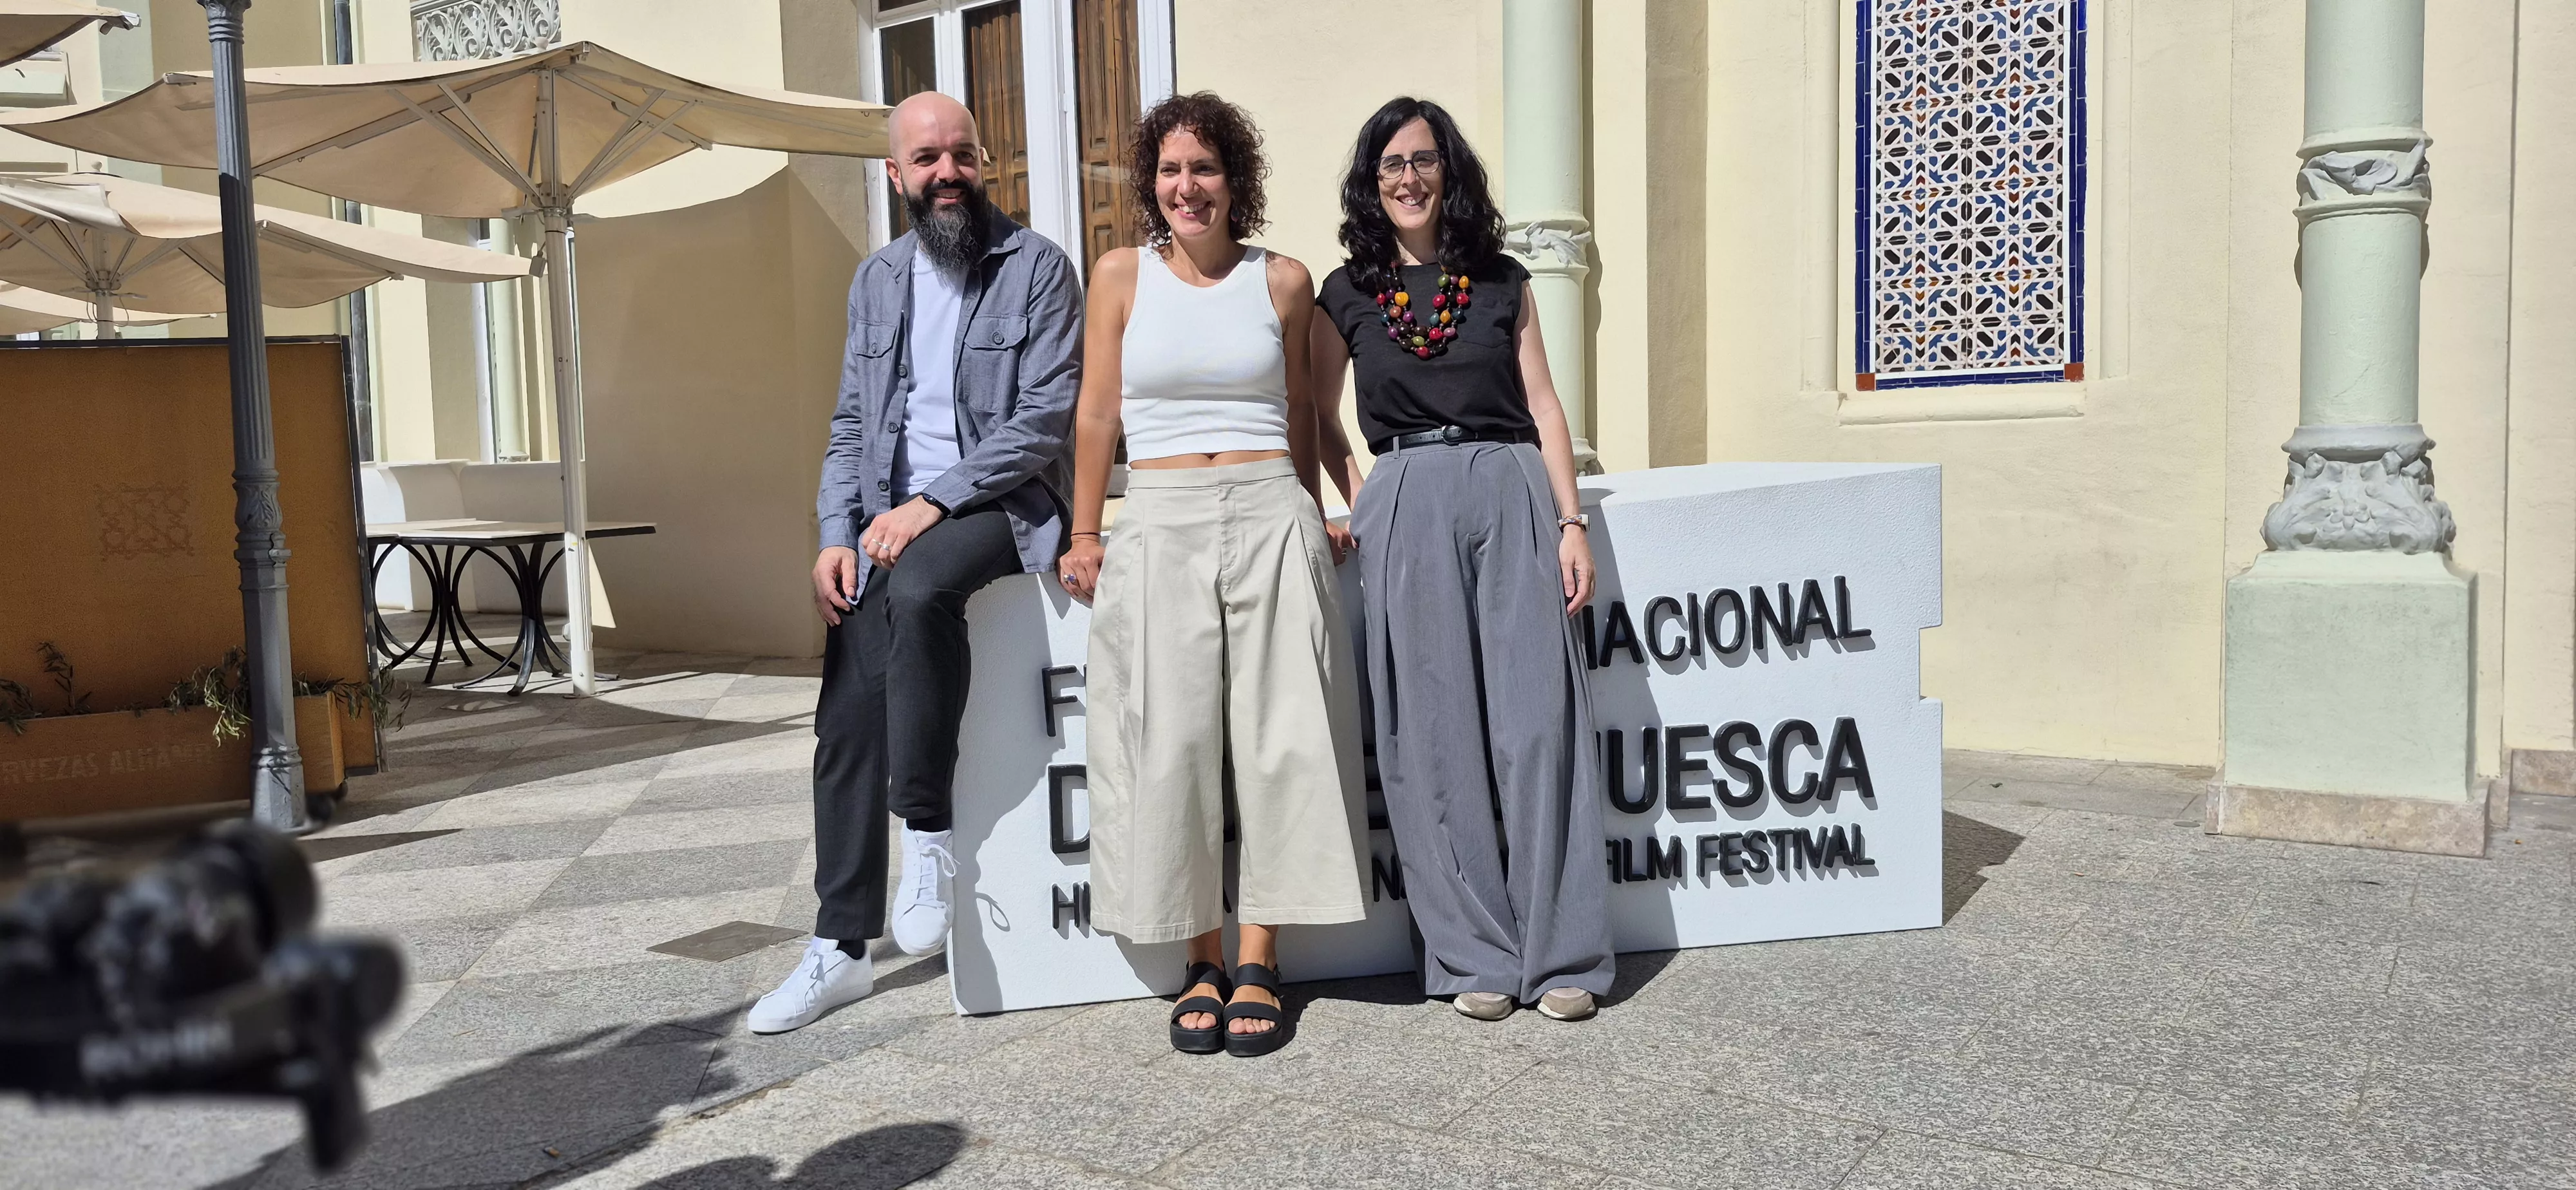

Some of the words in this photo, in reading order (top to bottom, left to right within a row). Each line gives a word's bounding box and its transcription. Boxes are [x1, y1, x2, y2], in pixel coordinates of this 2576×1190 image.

[1596, 717, 1874, 814] UESCA
[1605, 835, 1683, 884] ILM
[1696, 823, 1875, 878] FESTIVAL
